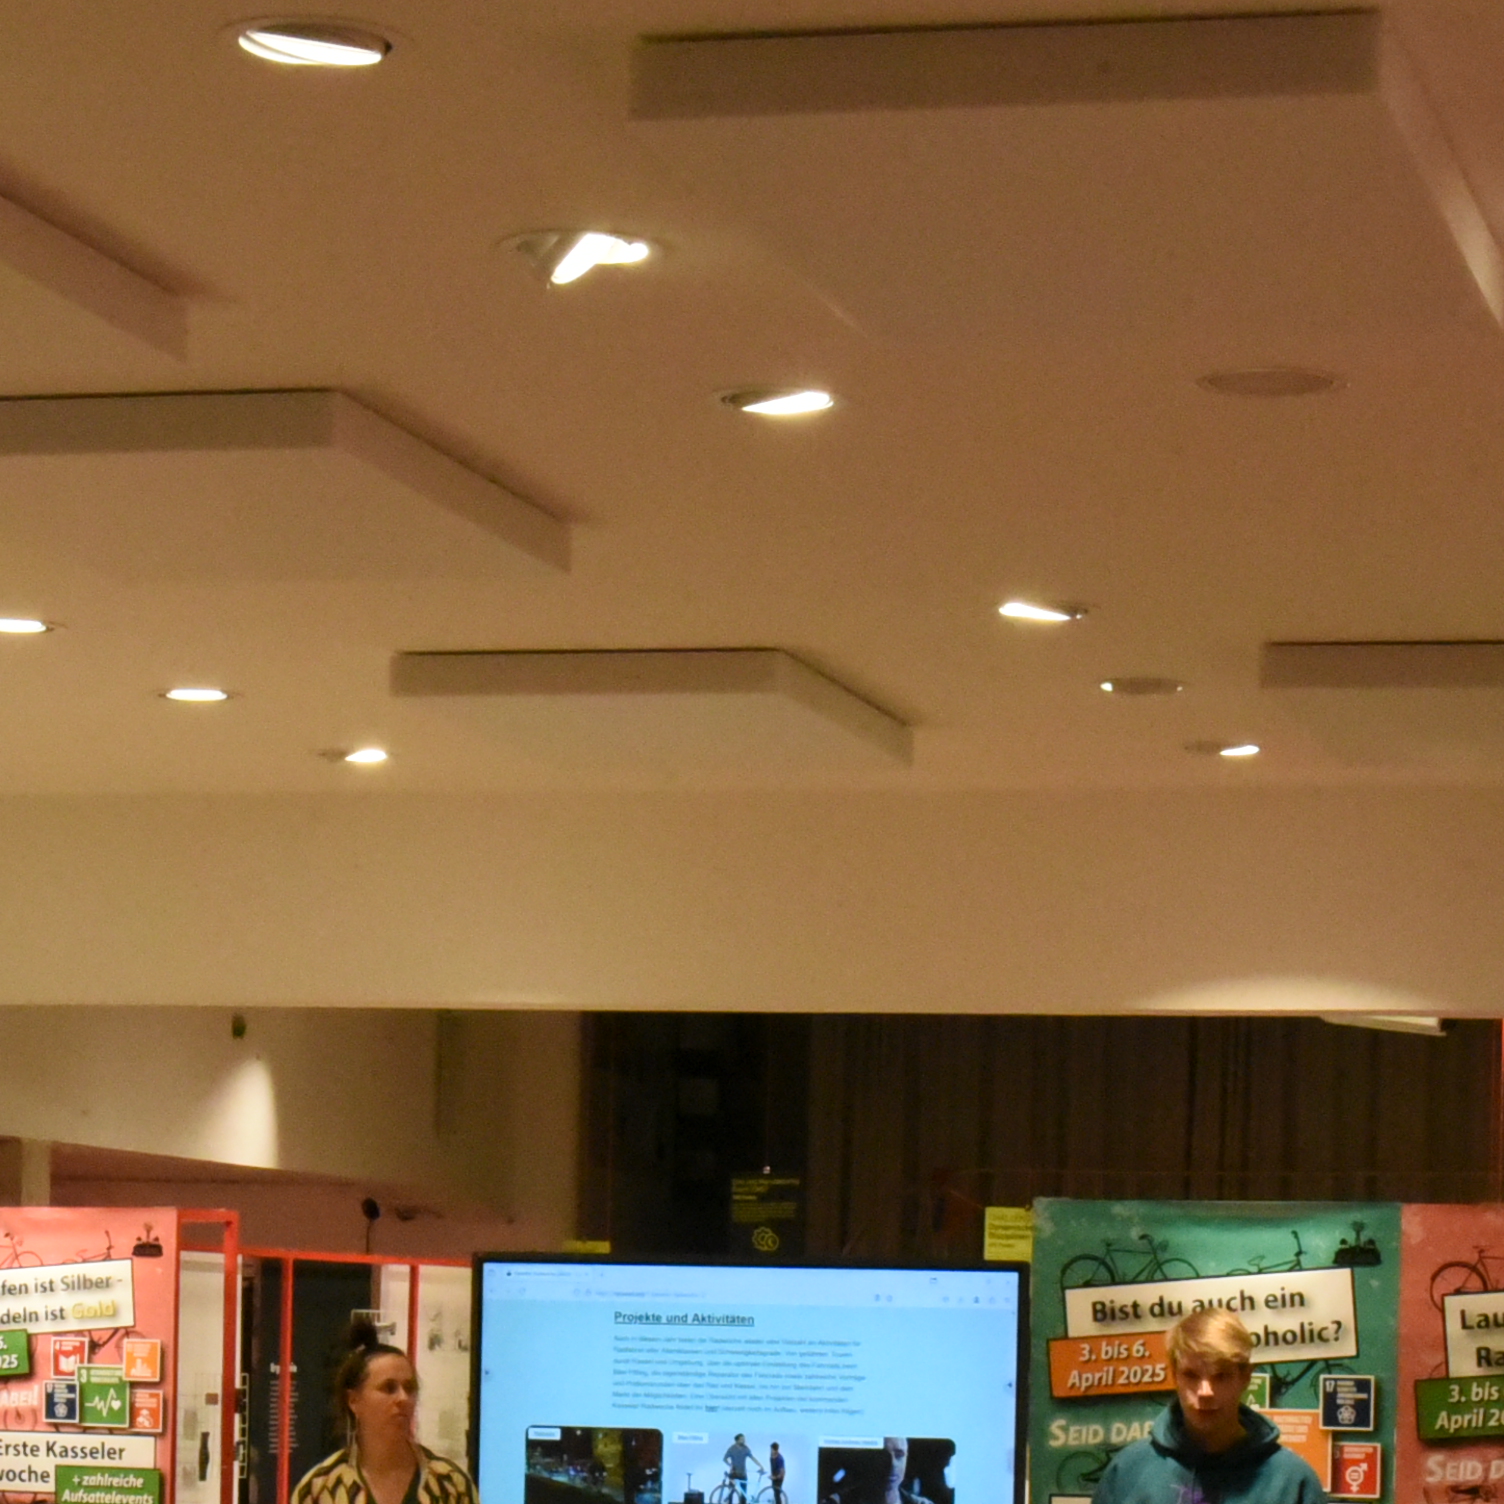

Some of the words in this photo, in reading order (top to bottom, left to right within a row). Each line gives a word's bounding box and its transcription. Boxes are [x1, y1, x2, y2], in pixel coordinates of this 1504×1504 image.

[34, 1277, 55, 1293] ist
[60, 1273, 112, 1291] Silber
[44, 1305, 66, 1321] ist
[72, 1300, 117, 1319] Gold
[1092, 1300, 1141, 1323] Bist
[1149, 1295, 1183, 1318] du
[1264, 1287, 1305, 1310] ein
[614, 1311, 662, 1325] Projekte
[666, 1313, 688, 1324] und
[691, 1312, 755, 1326] Aktivitäten
[1079, 1343, 1097, 1361] 3.
[1101, 1341, 1128, 1360] bis
[1132, 1340, 1150, 1358] 6.
[1067, 1366, 1116, 1391] April
[1118, 1363, 1166, 1385] 2025
[1448, 1384, 1467, 1404] 3.
[1472, 1380, 1499, 1401] bis
[1435, 1408, 1484, 1432] April
[46, 1440, 126, 1460] Kasseler
[82, 1473, 144, 1488] zahlreiche
